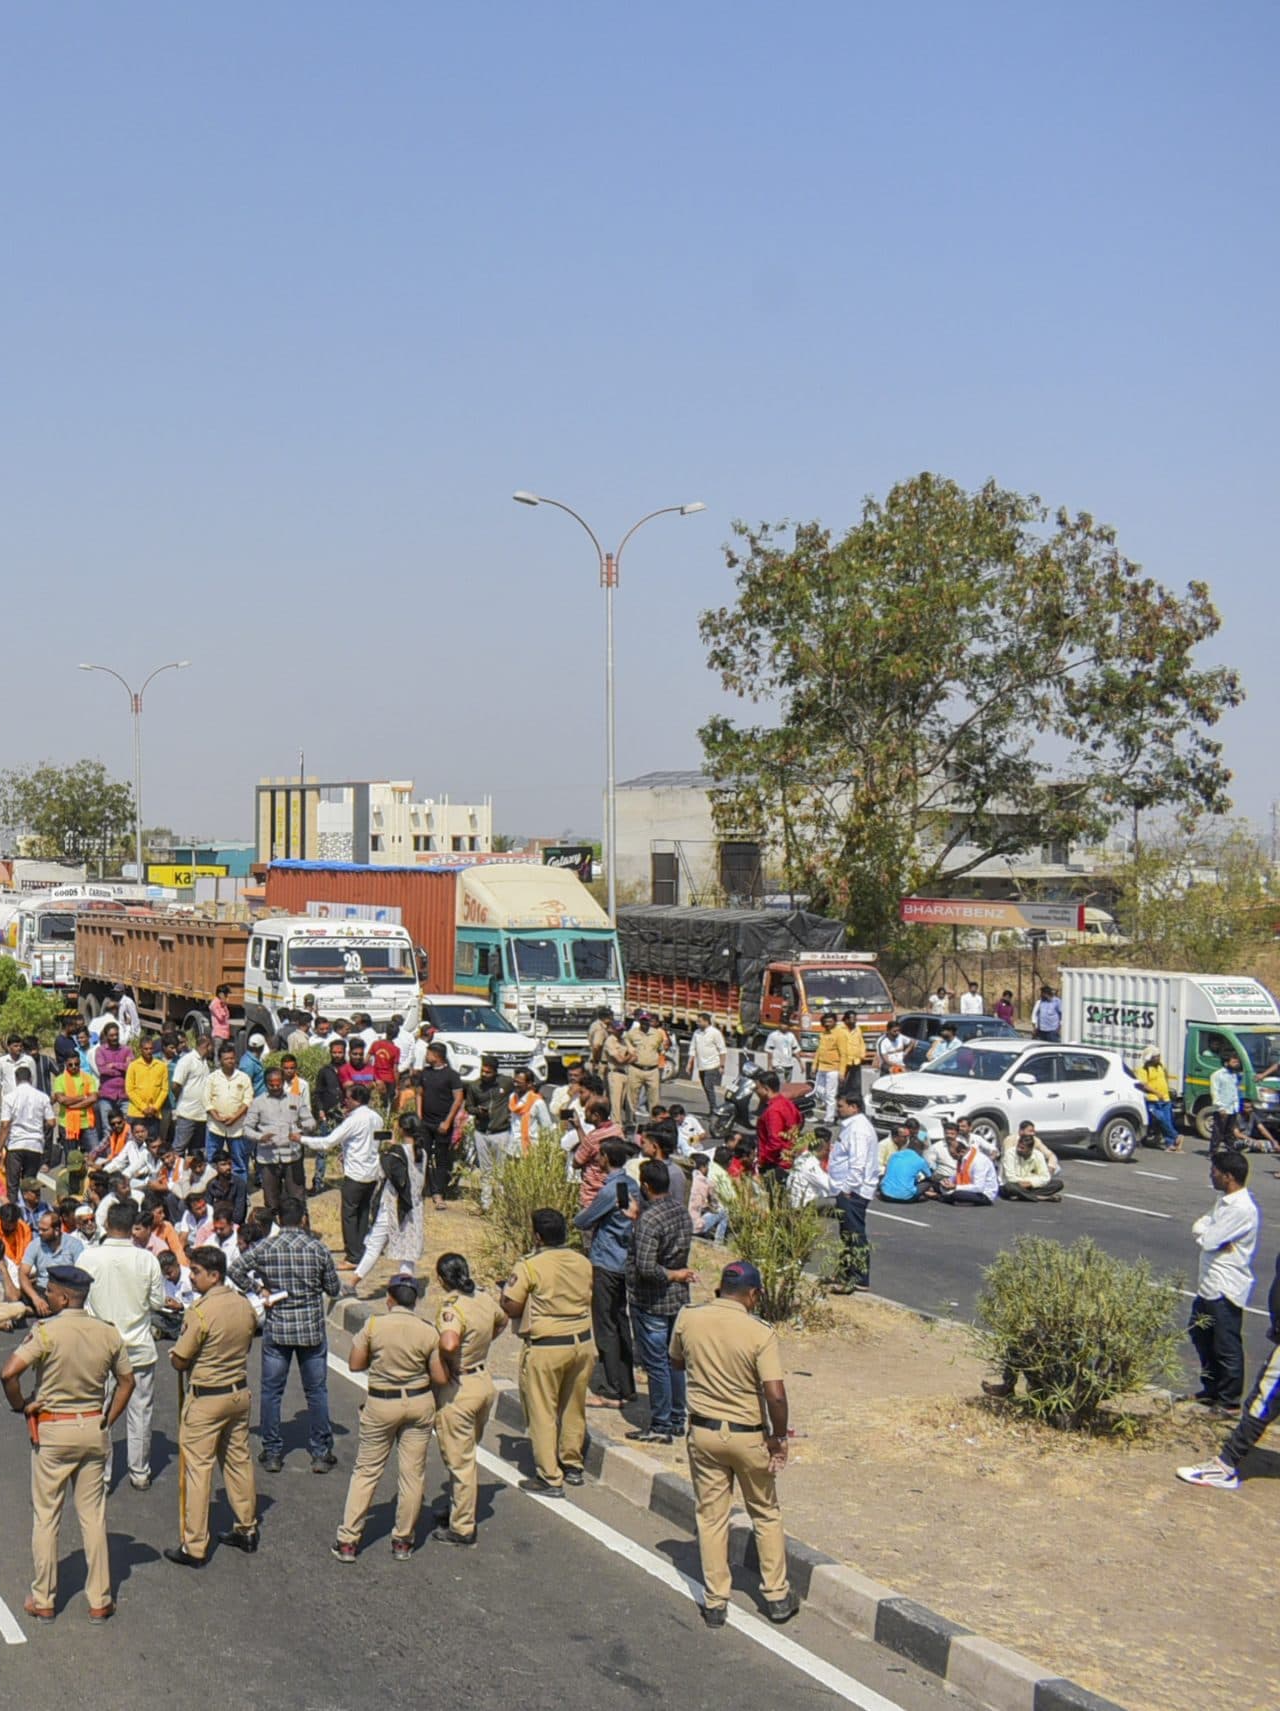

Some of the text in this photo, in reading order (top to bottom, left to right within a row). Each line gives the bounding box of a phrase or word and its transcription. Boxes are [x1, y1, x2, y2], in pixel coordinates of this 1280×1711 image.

[547, 852, 582, 868] Galaxy
[54, 887, 78, 897] GOODS
[463, 892, 489, 924] 5016
[903, 903, 1007, 920] BHARATBENZ
[343, 951, 361, 972] 29
